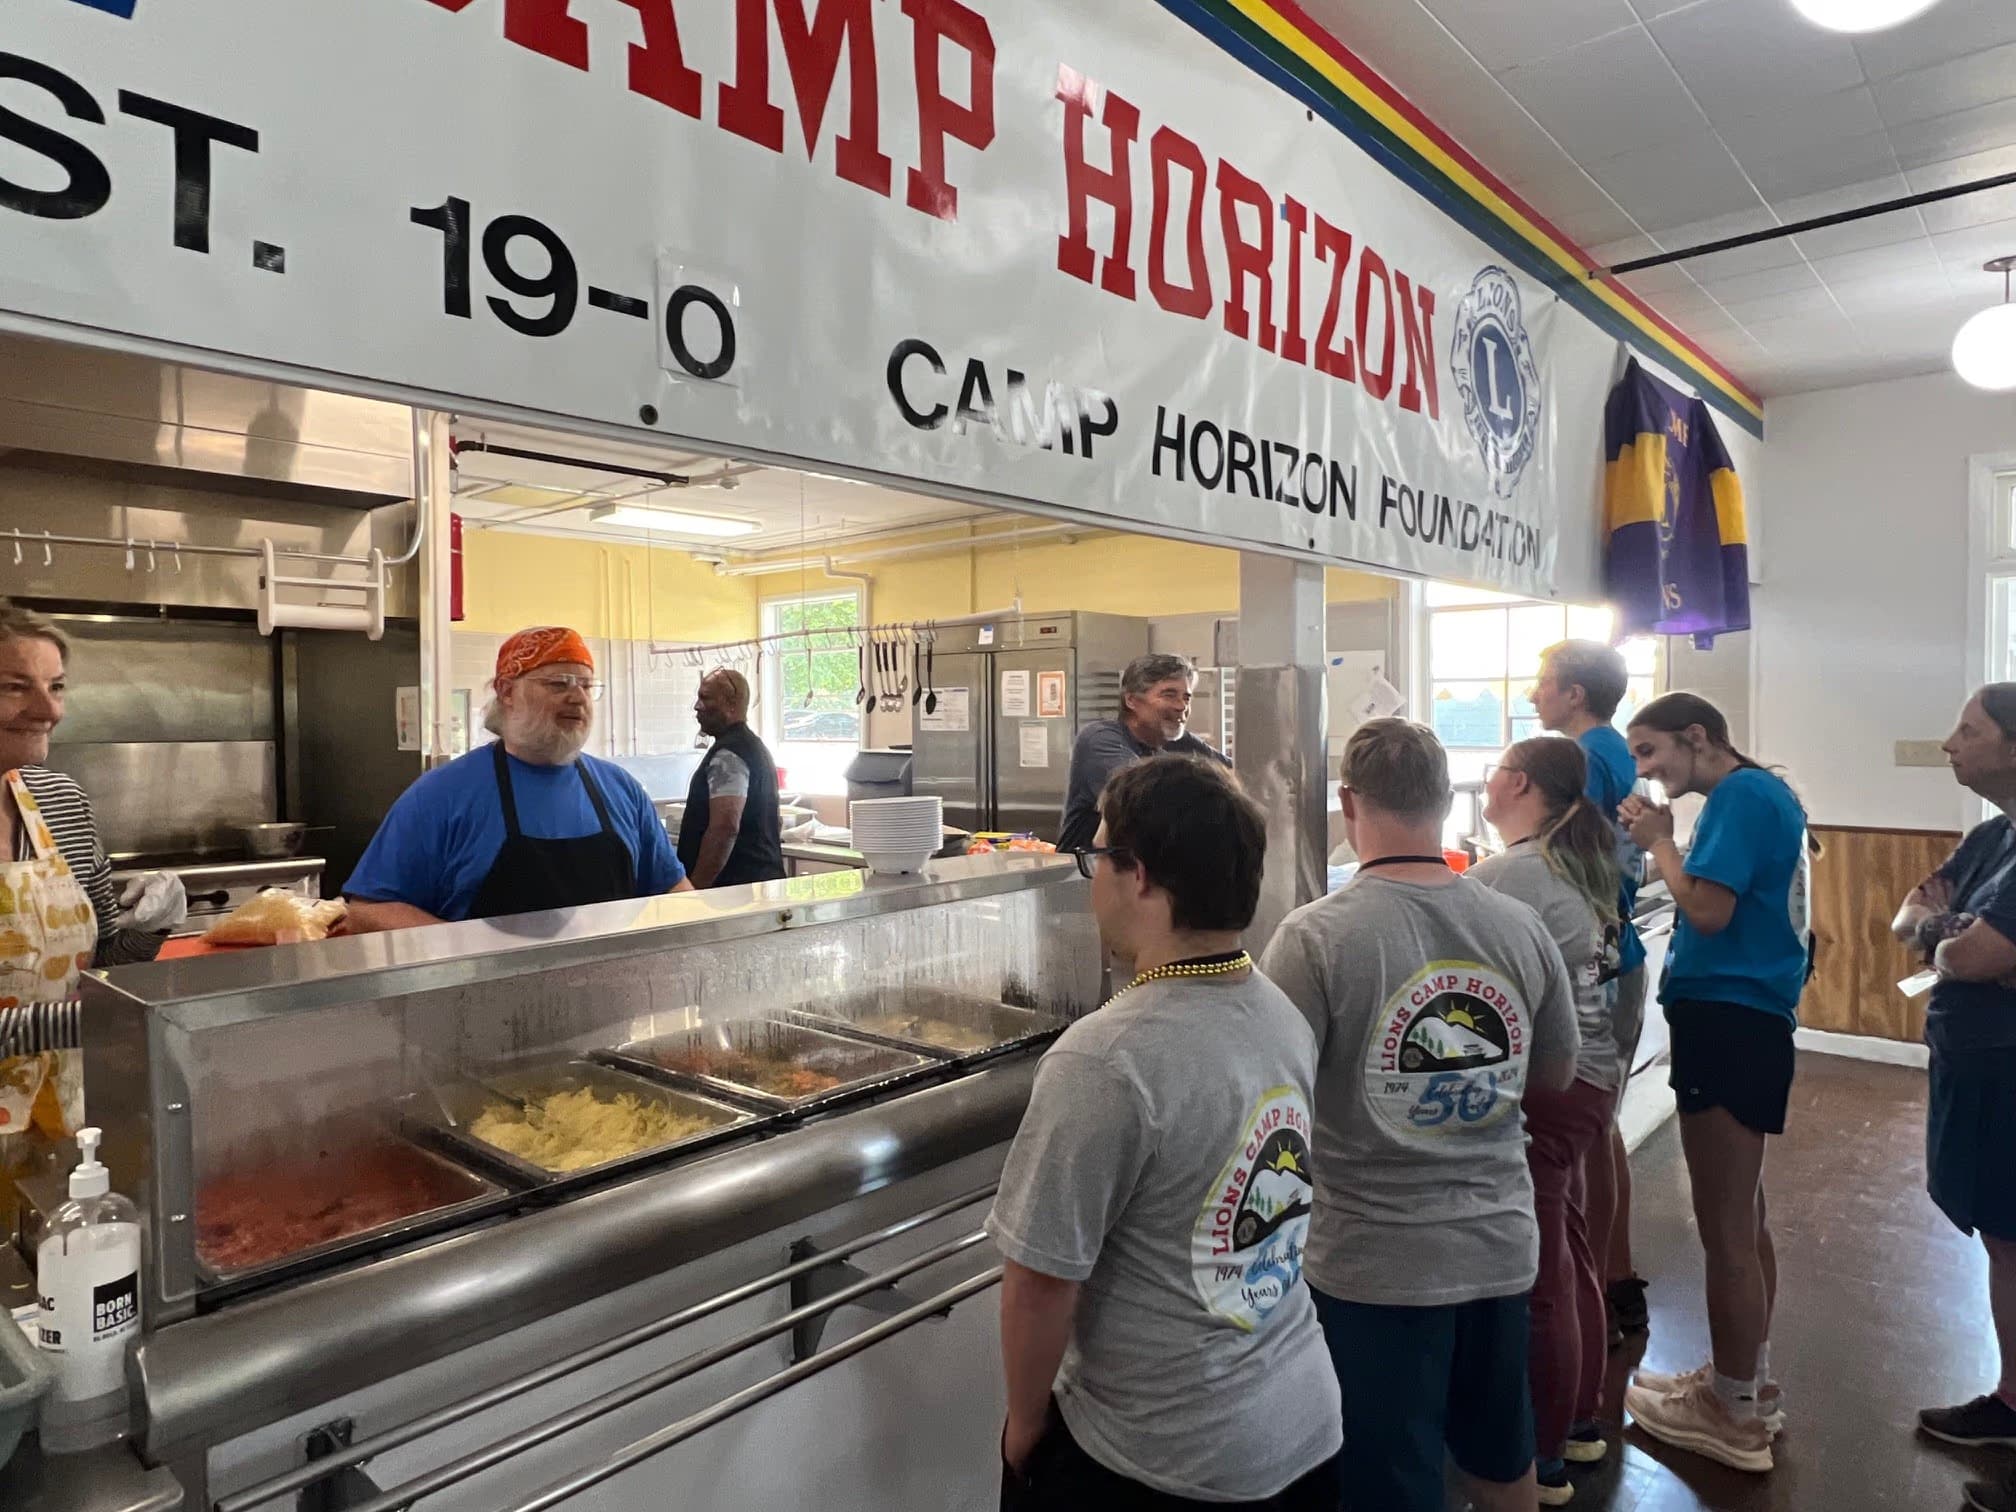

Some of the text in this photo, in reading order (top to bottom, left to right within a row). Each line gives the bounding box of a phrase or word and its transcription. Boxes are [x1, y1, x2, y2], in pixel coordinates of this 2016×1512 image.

[1055, 62, 1440, 421] HORIZON
[1477, 281, 1516, 332] LIONS
[1482, 337, 1514, 420] L
[887, 338, 1119, 459] CAMP
[1152, 405, 1357, 521] HORIZON
[1379, 474, 1540, 569] FOUNDATON
[1381, 975, 1522, 1073] LIONS CAMP HORIZON
[1212, 1167, 1247, 1256] LIONS
[1246, 1108, 1281, 1161] CAMP
[96, 1292, 132, 1317] BORN
[1214, 1264, 1244, 1282] 1974
